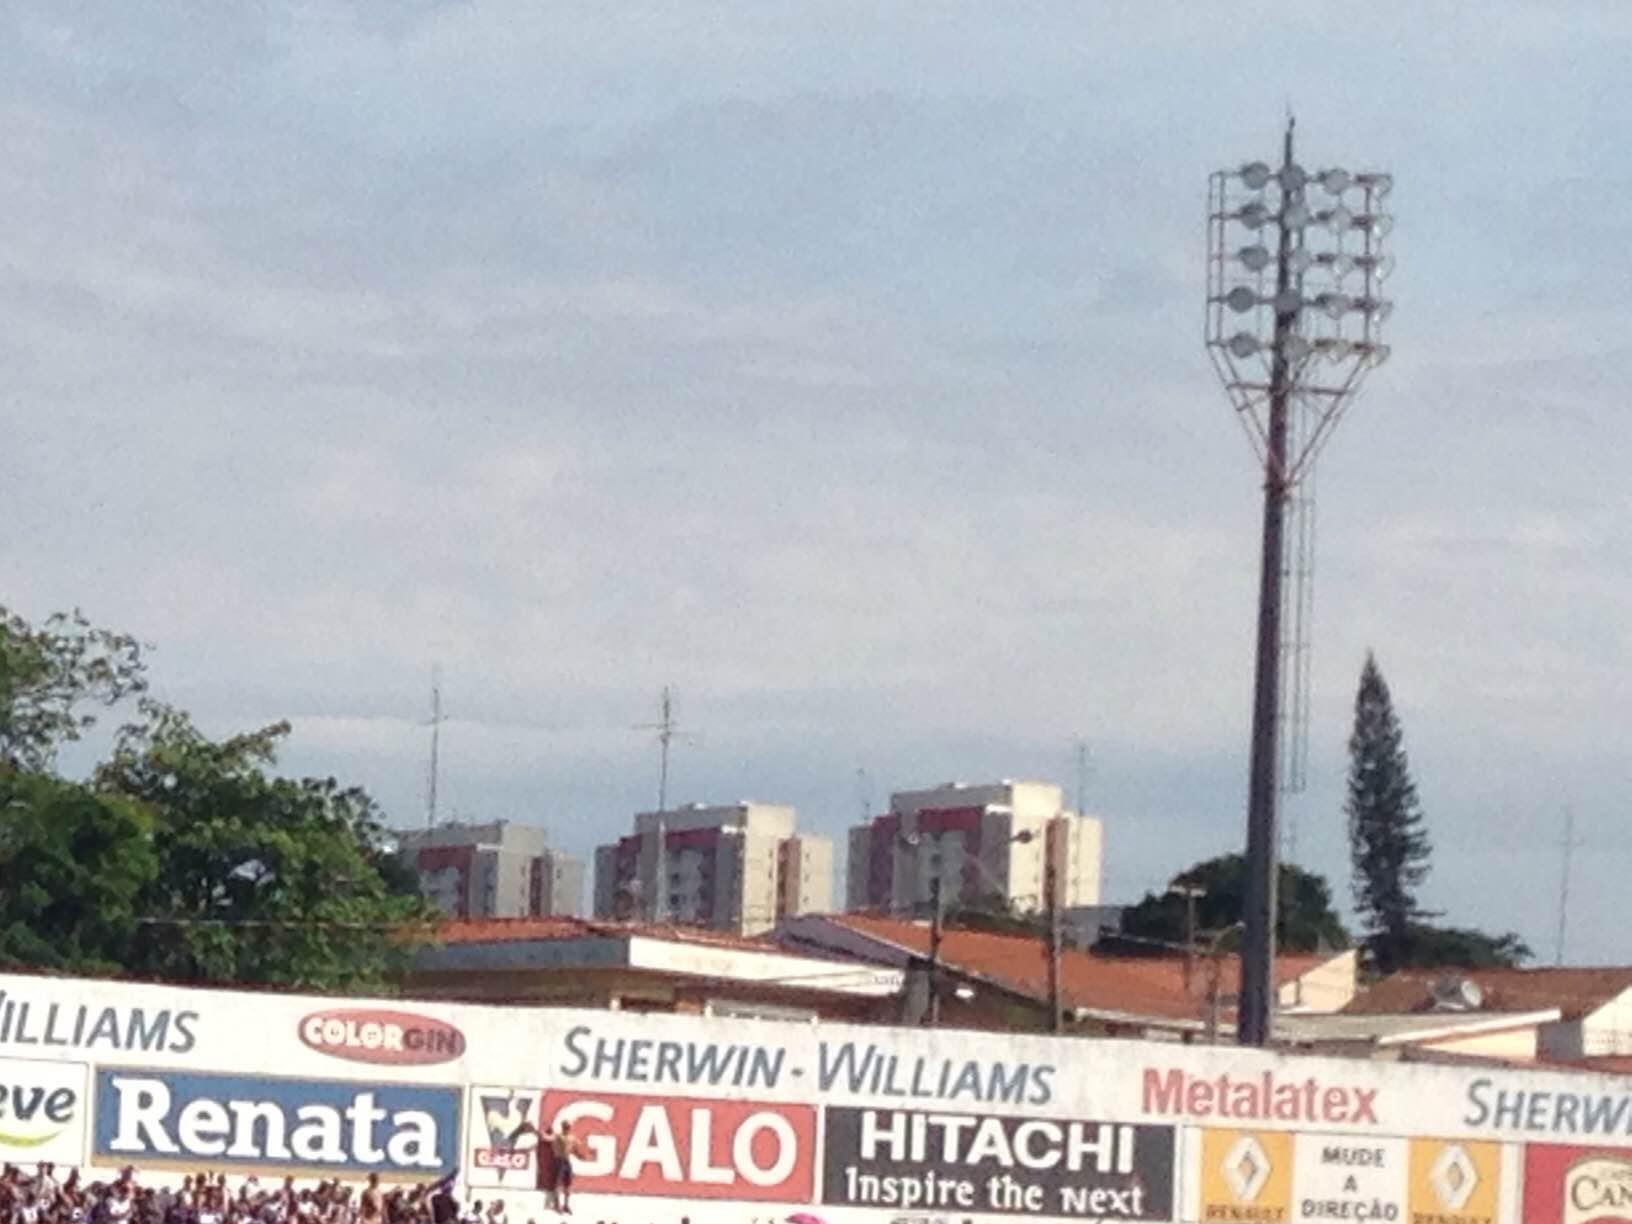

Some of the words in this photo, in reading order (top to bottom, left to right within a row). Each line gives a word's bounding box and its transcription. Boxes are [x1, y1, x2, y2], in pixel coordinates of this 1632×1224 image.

[304, 1017, 457, 1053] COLORGIN
[1141, 1067, 1379, 1124] Metalatex
[110, 1076, 443, 1168] Renata
[553, 1101, 798, 1187] GALO
[860, 1111, 1134, 1174] HITACHI
[1321, 1148, 1385, 1168] MUDE
[845, 1166, 974, 1208] Inspire
[987, 1174, 1044, 1211] the
[1060, 1185, 1144, 1215] Next
[1343, 1174, 1357, 1192] A
[1301, 1198, 1399, 1222] DIREÇÃO
